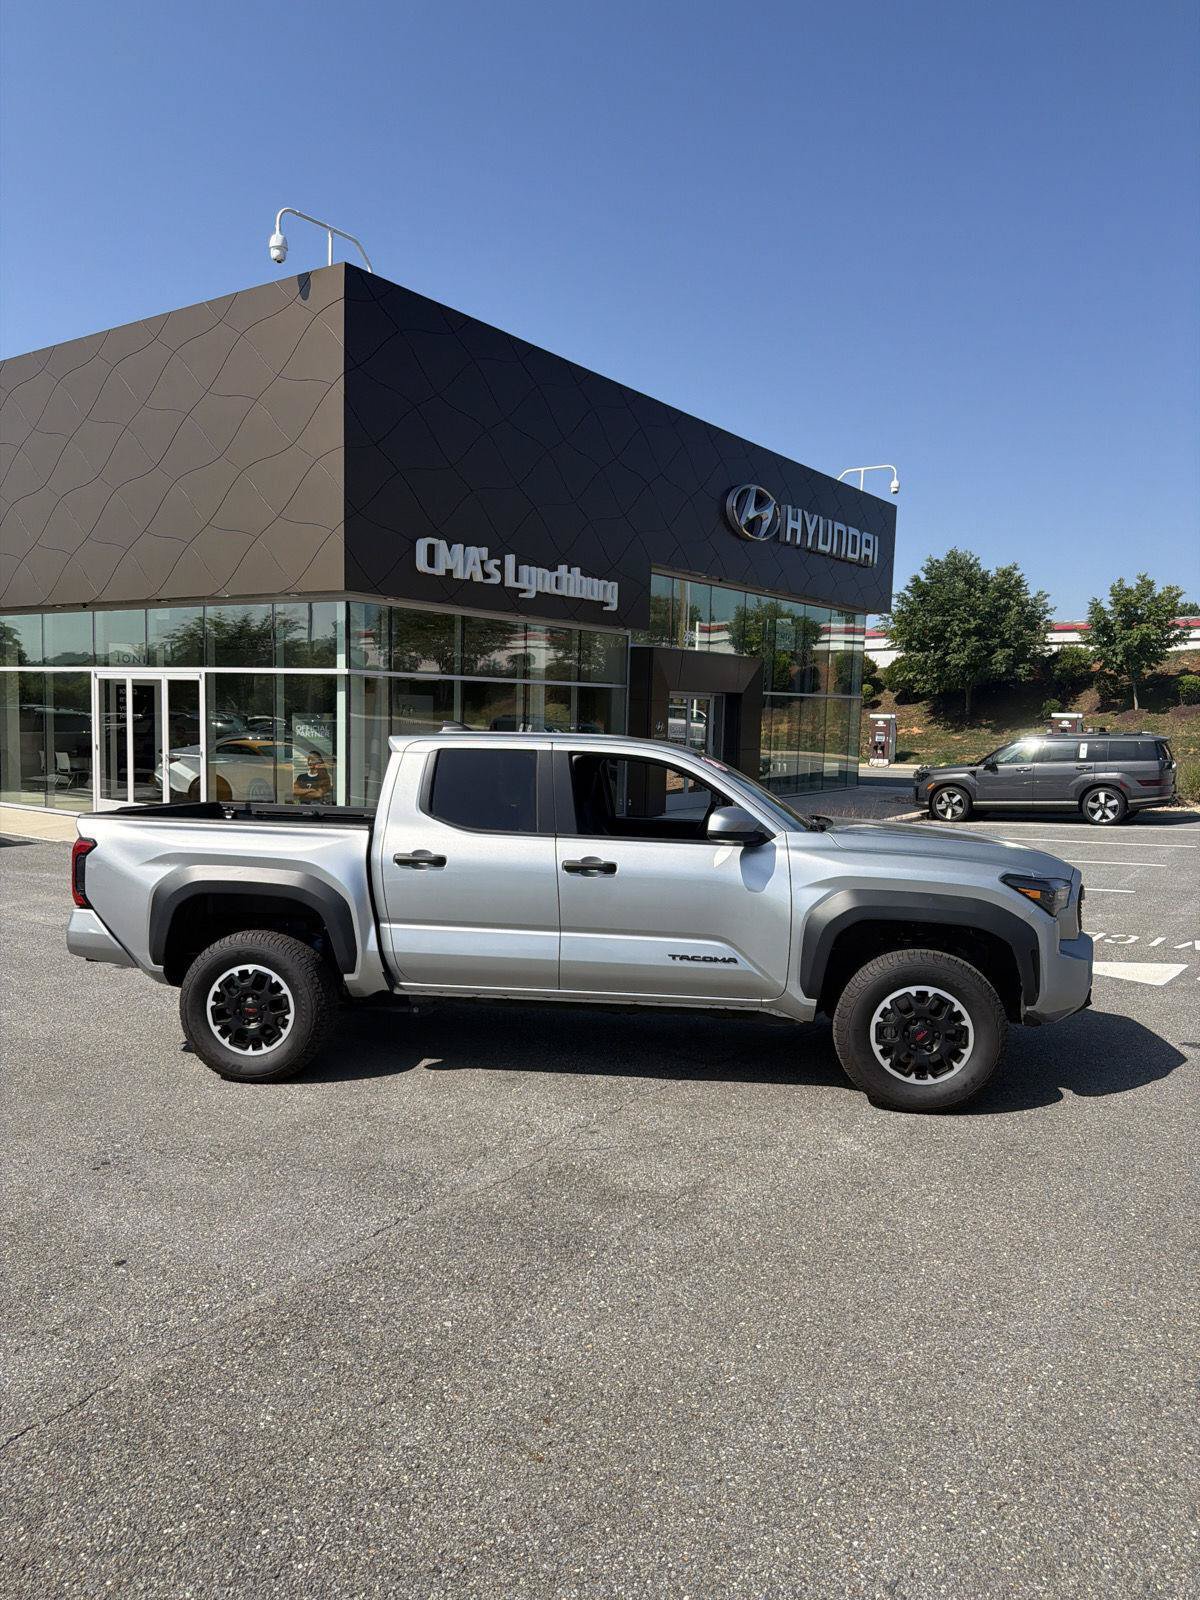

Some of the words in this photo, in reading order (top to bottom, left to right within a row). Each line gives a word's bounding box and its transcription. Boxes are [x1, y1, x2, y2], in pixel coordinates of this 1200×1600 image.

[784, 504, 879, 567] HYUNDAI
[415, 536, 501, 584] CMA's
[503, 553, 619, 612] Lynchburg
[667, 954, 739, 964] TACOMA
